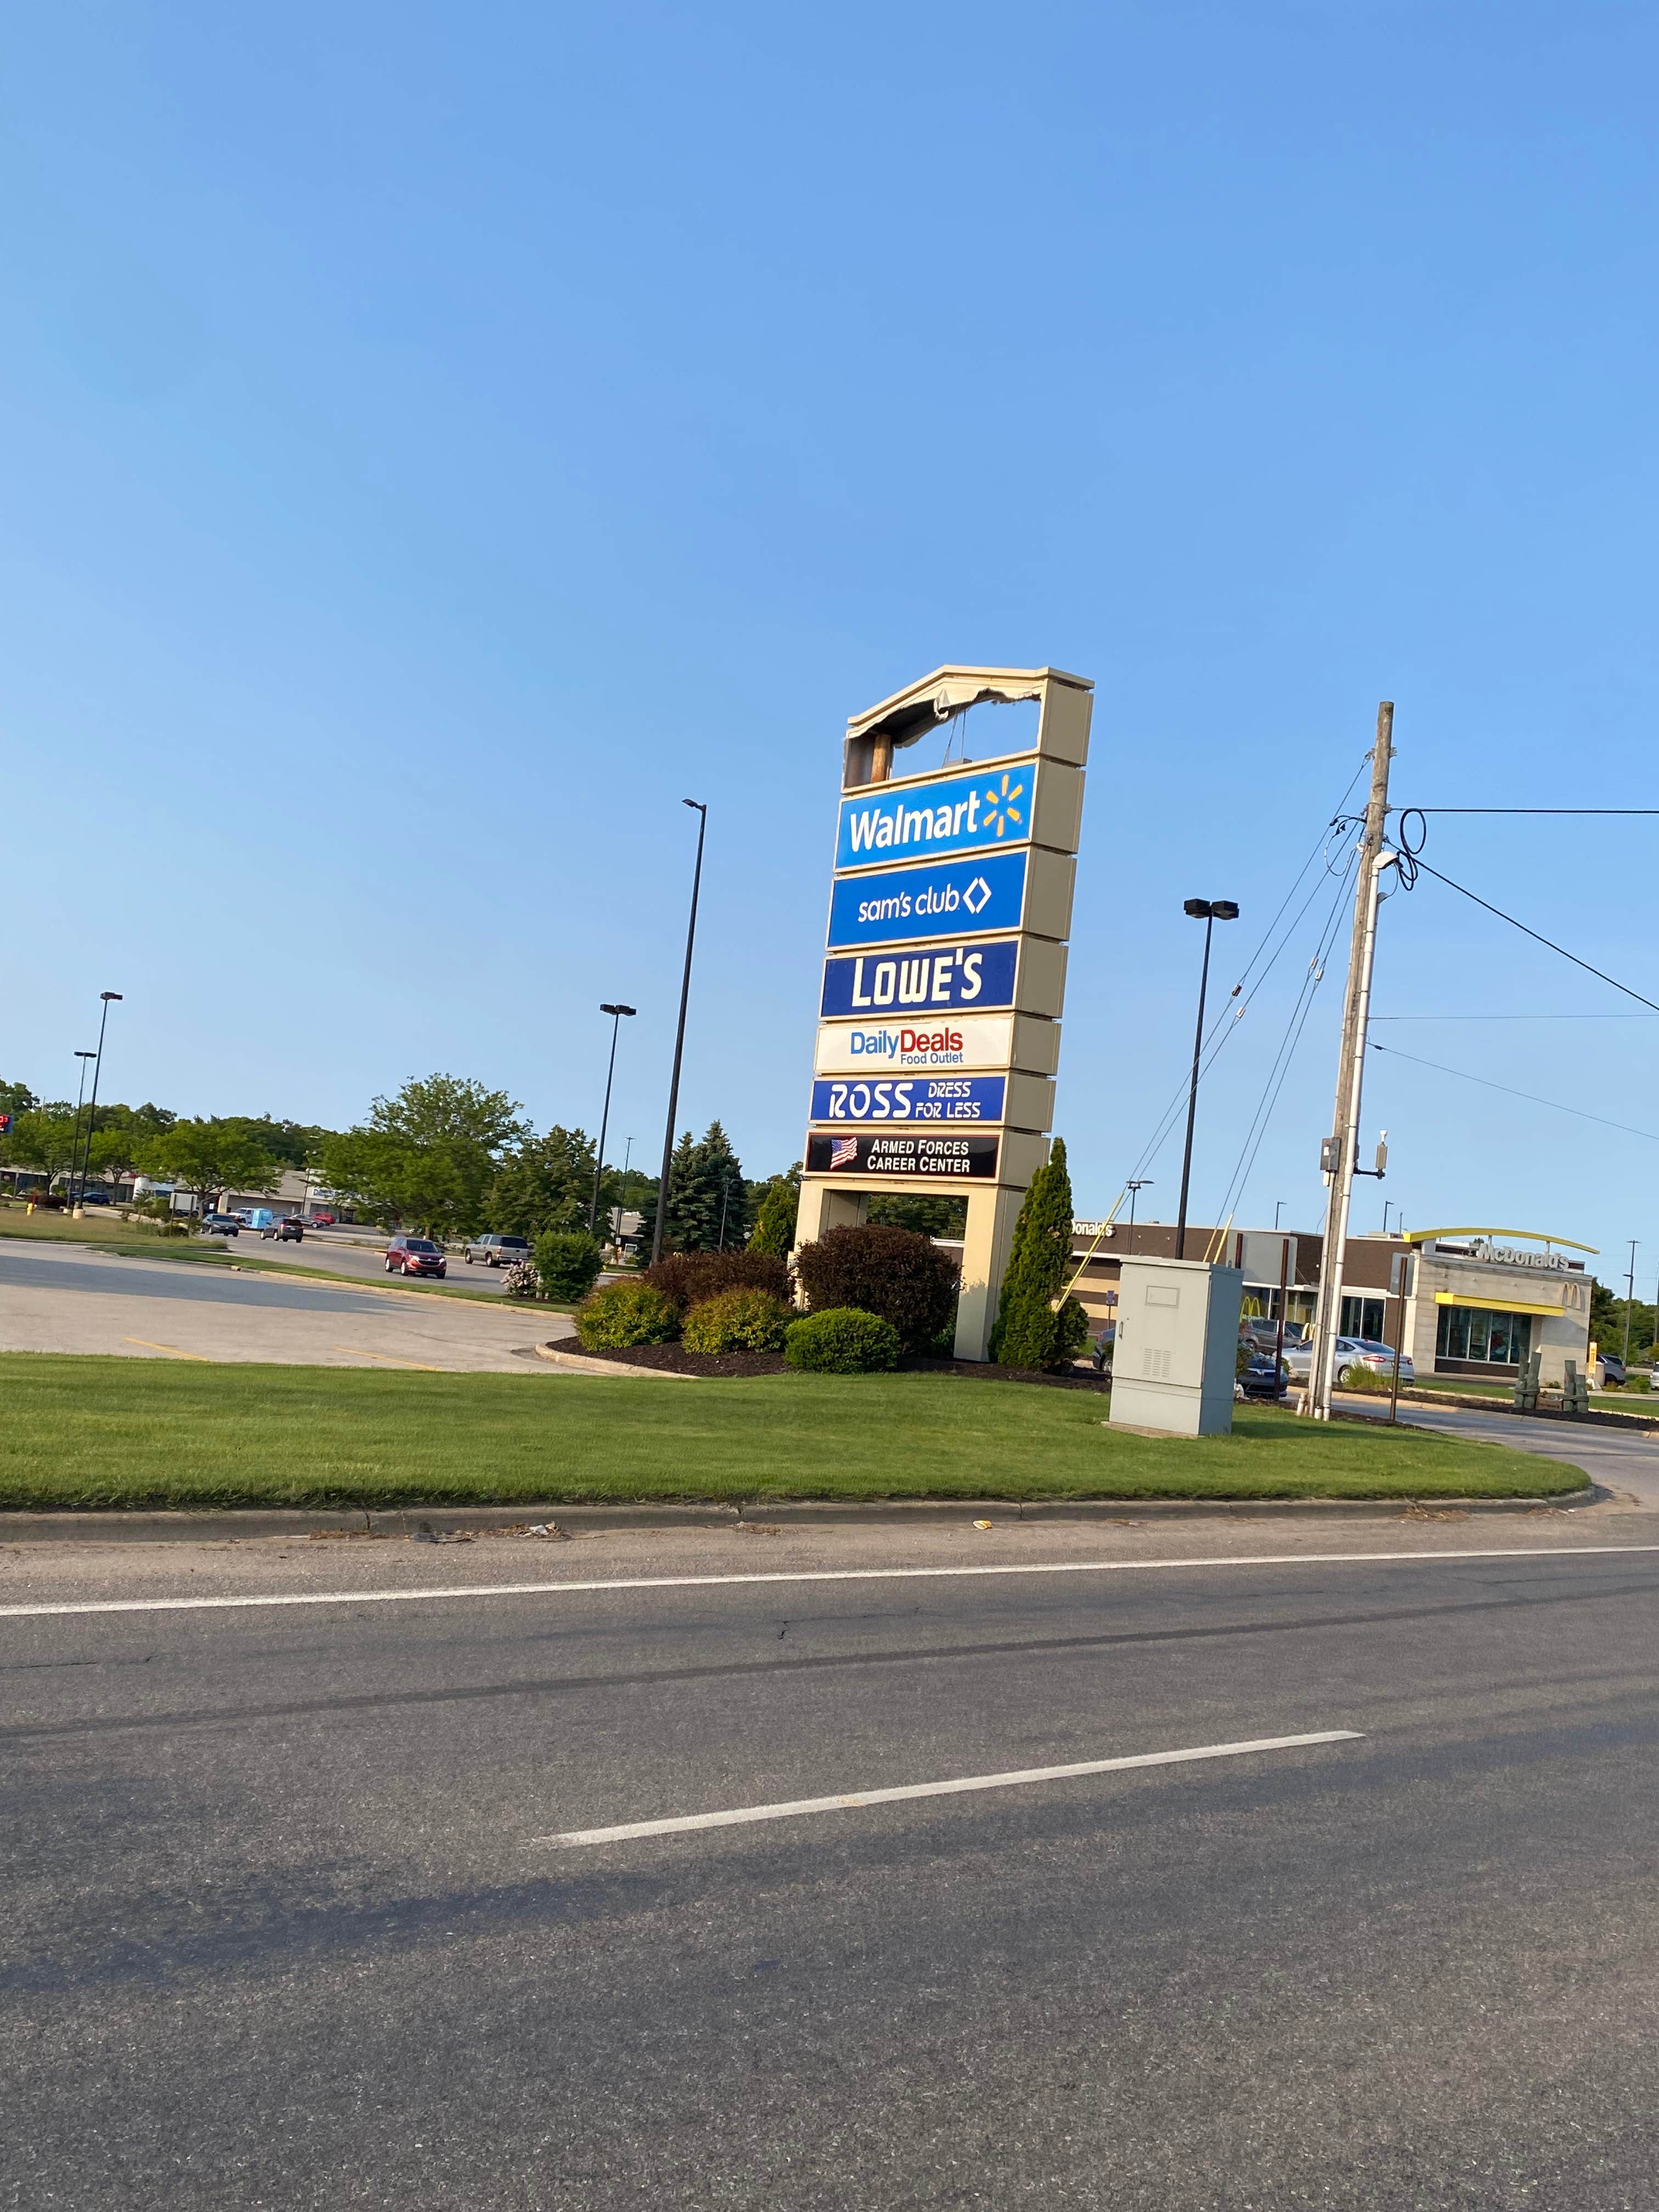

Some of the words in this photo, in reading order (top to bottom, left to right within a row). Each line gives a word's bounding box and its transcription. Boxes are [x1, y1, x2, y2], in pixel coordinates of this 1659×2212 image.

[850, 791, 980, 852] Walmart
[857, 891, 911, 922] sam's
[915, 883, 960, 915] club
[852, 948, 983, 1007] LOWE'S
[901, 1053, 927, 1065] Food
[930, 1052, 963, 1063] Outlet
[928, 1081, 972, 1098] DRESS
[829, 1083, 913, 1118] ROSS
[915, 1102, 942, 1118] FOR
[946, 1102, 981, 1118] LESS
[871, 1139, 915, 1154] ARMED
[918, 1139, 969, 1155] FORCES
[867, 1155, 916, 1171] CAREER
[919, 1156, 970, 1172] CENTER
[1477, 1243, 1570, 1269] McDonald's
